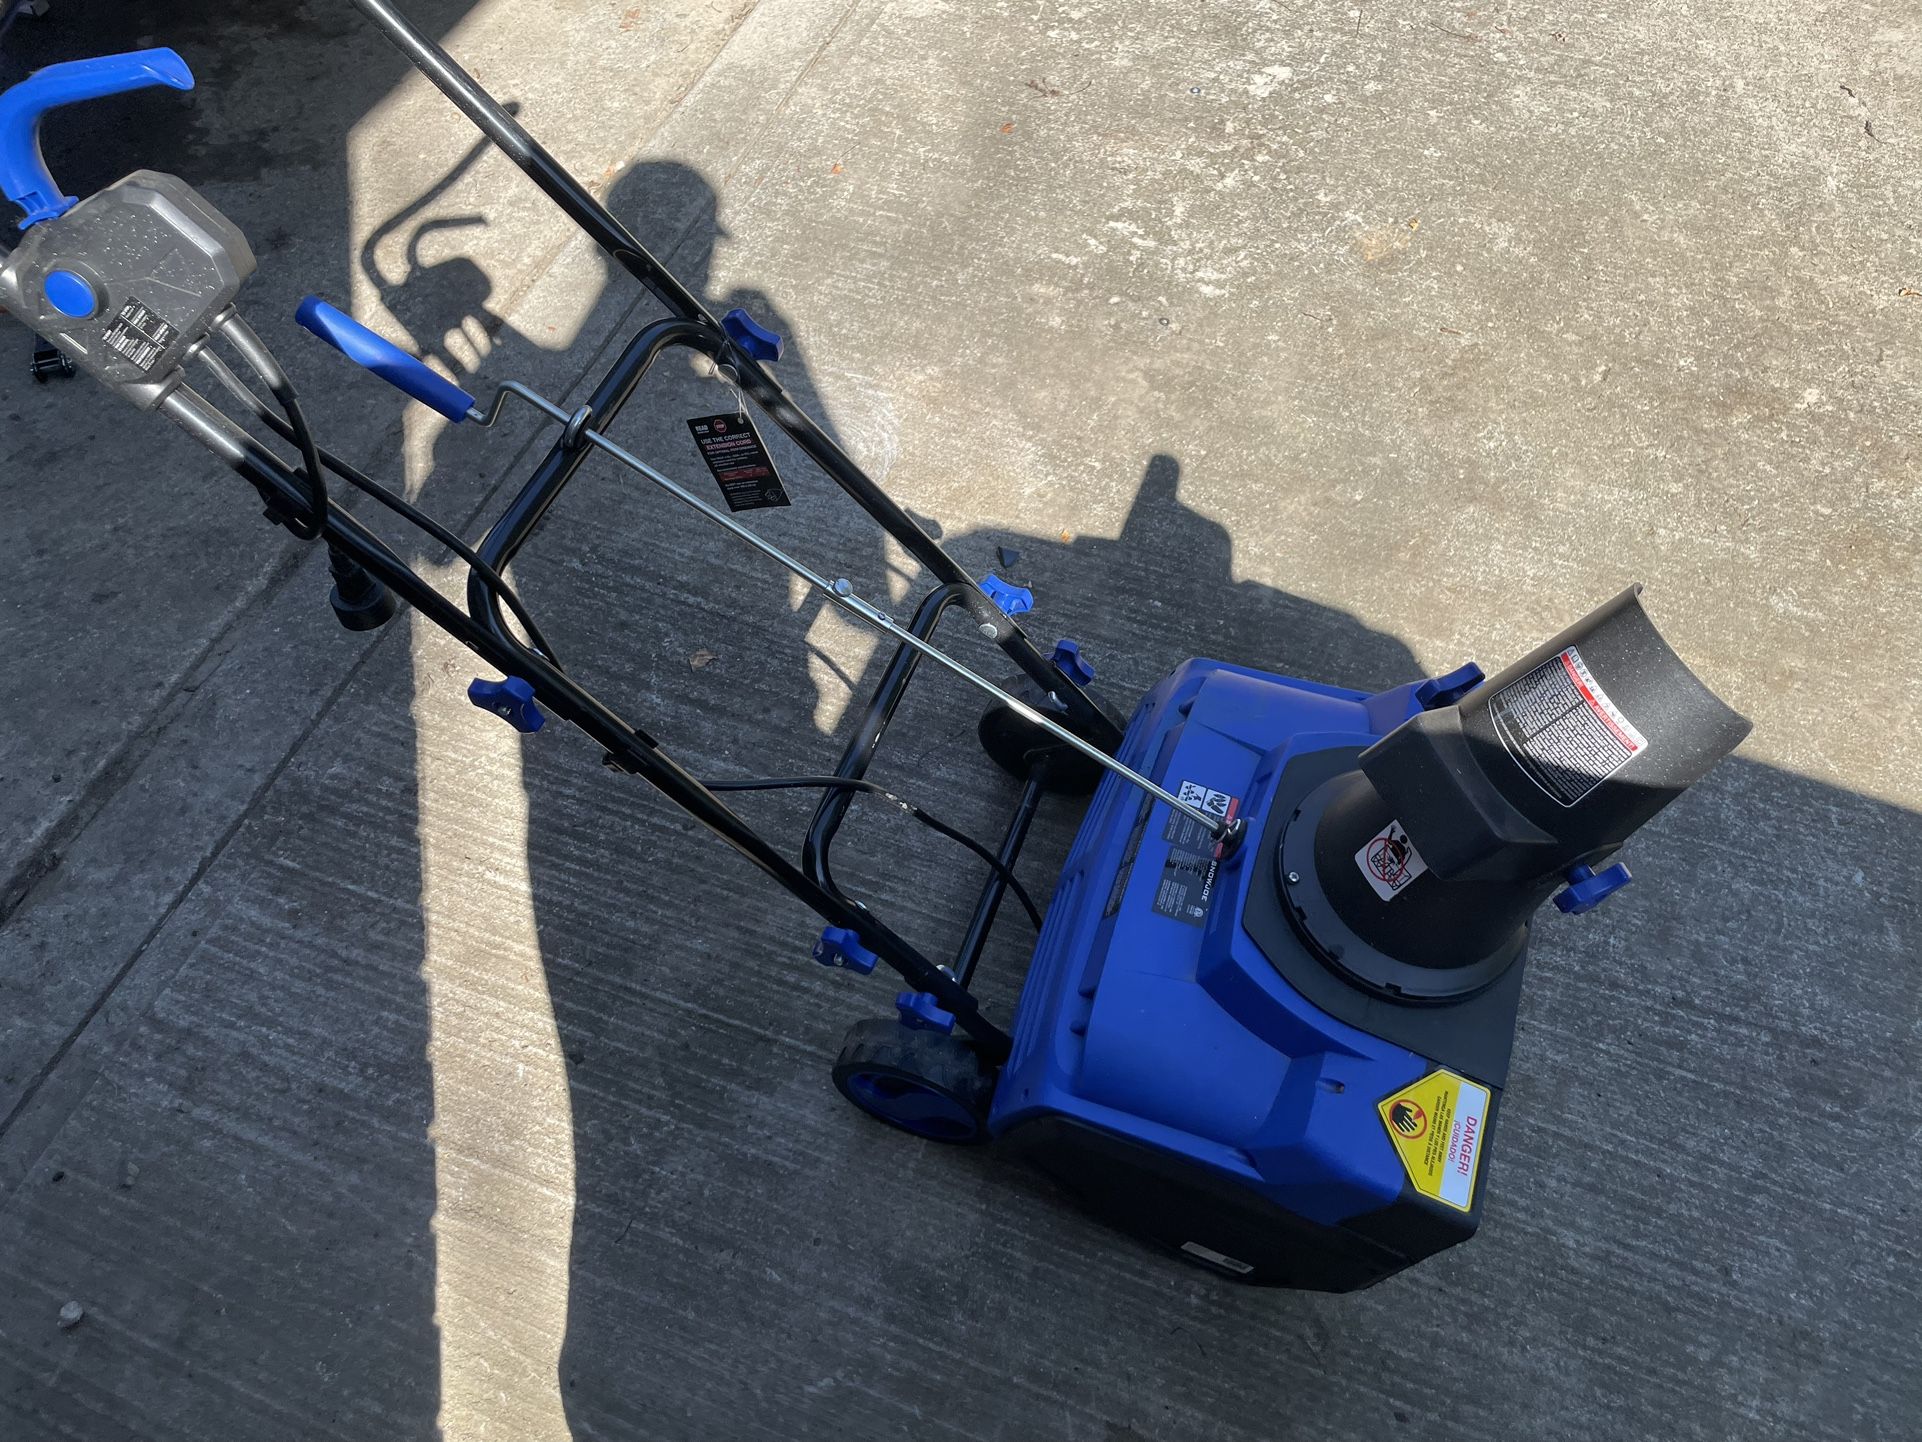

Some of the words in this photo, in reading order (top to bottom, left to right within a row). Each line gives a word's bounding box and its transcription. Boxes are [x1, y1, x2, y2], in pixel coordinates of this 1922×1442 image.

[706, 442, 735, 450] EXTENSION
[724, 432, 750, 441] CORRECT
[1202, 860, 1217, 902] SNOWJOE
[1448, 1121, 1460, 1162] ¡CUIDADO!
[1457, 1116, 1477, 1176] DANGER!
